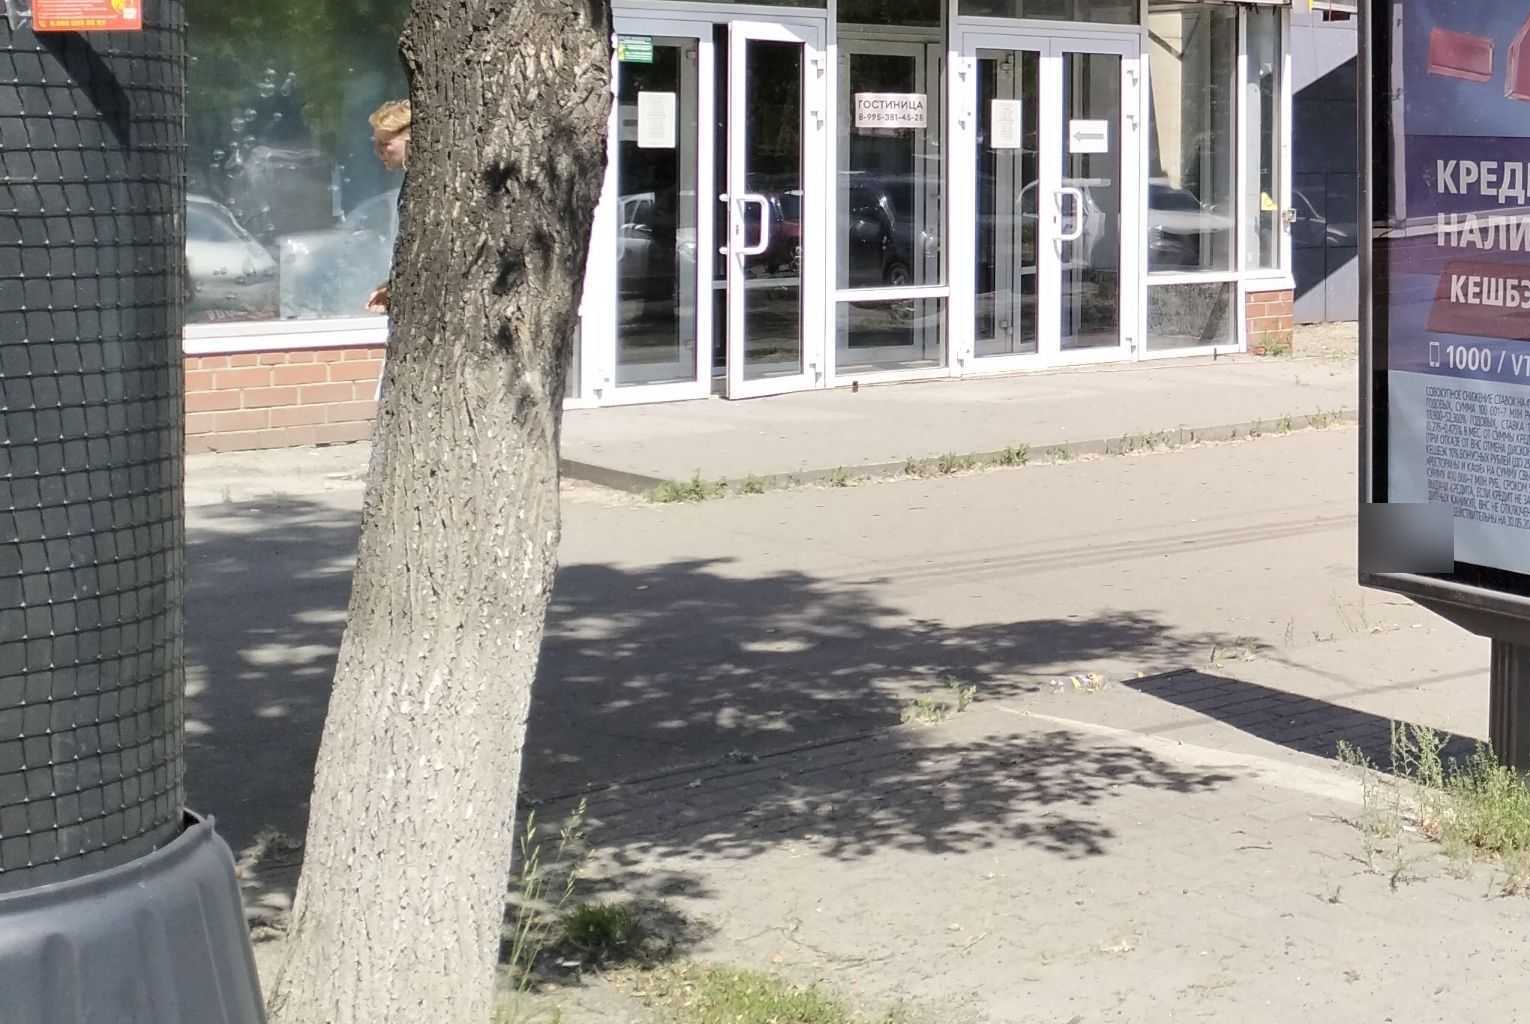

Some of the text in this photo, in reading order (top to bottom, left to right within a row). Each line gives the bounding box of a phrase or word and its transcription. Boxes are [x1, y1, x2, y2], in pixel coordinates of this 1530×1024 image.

[858, 99, 924, 111] ГОСТИНИЦА
[1446, 344, 1492, 372] 1000
[1497, 350, 1507, 374] /
